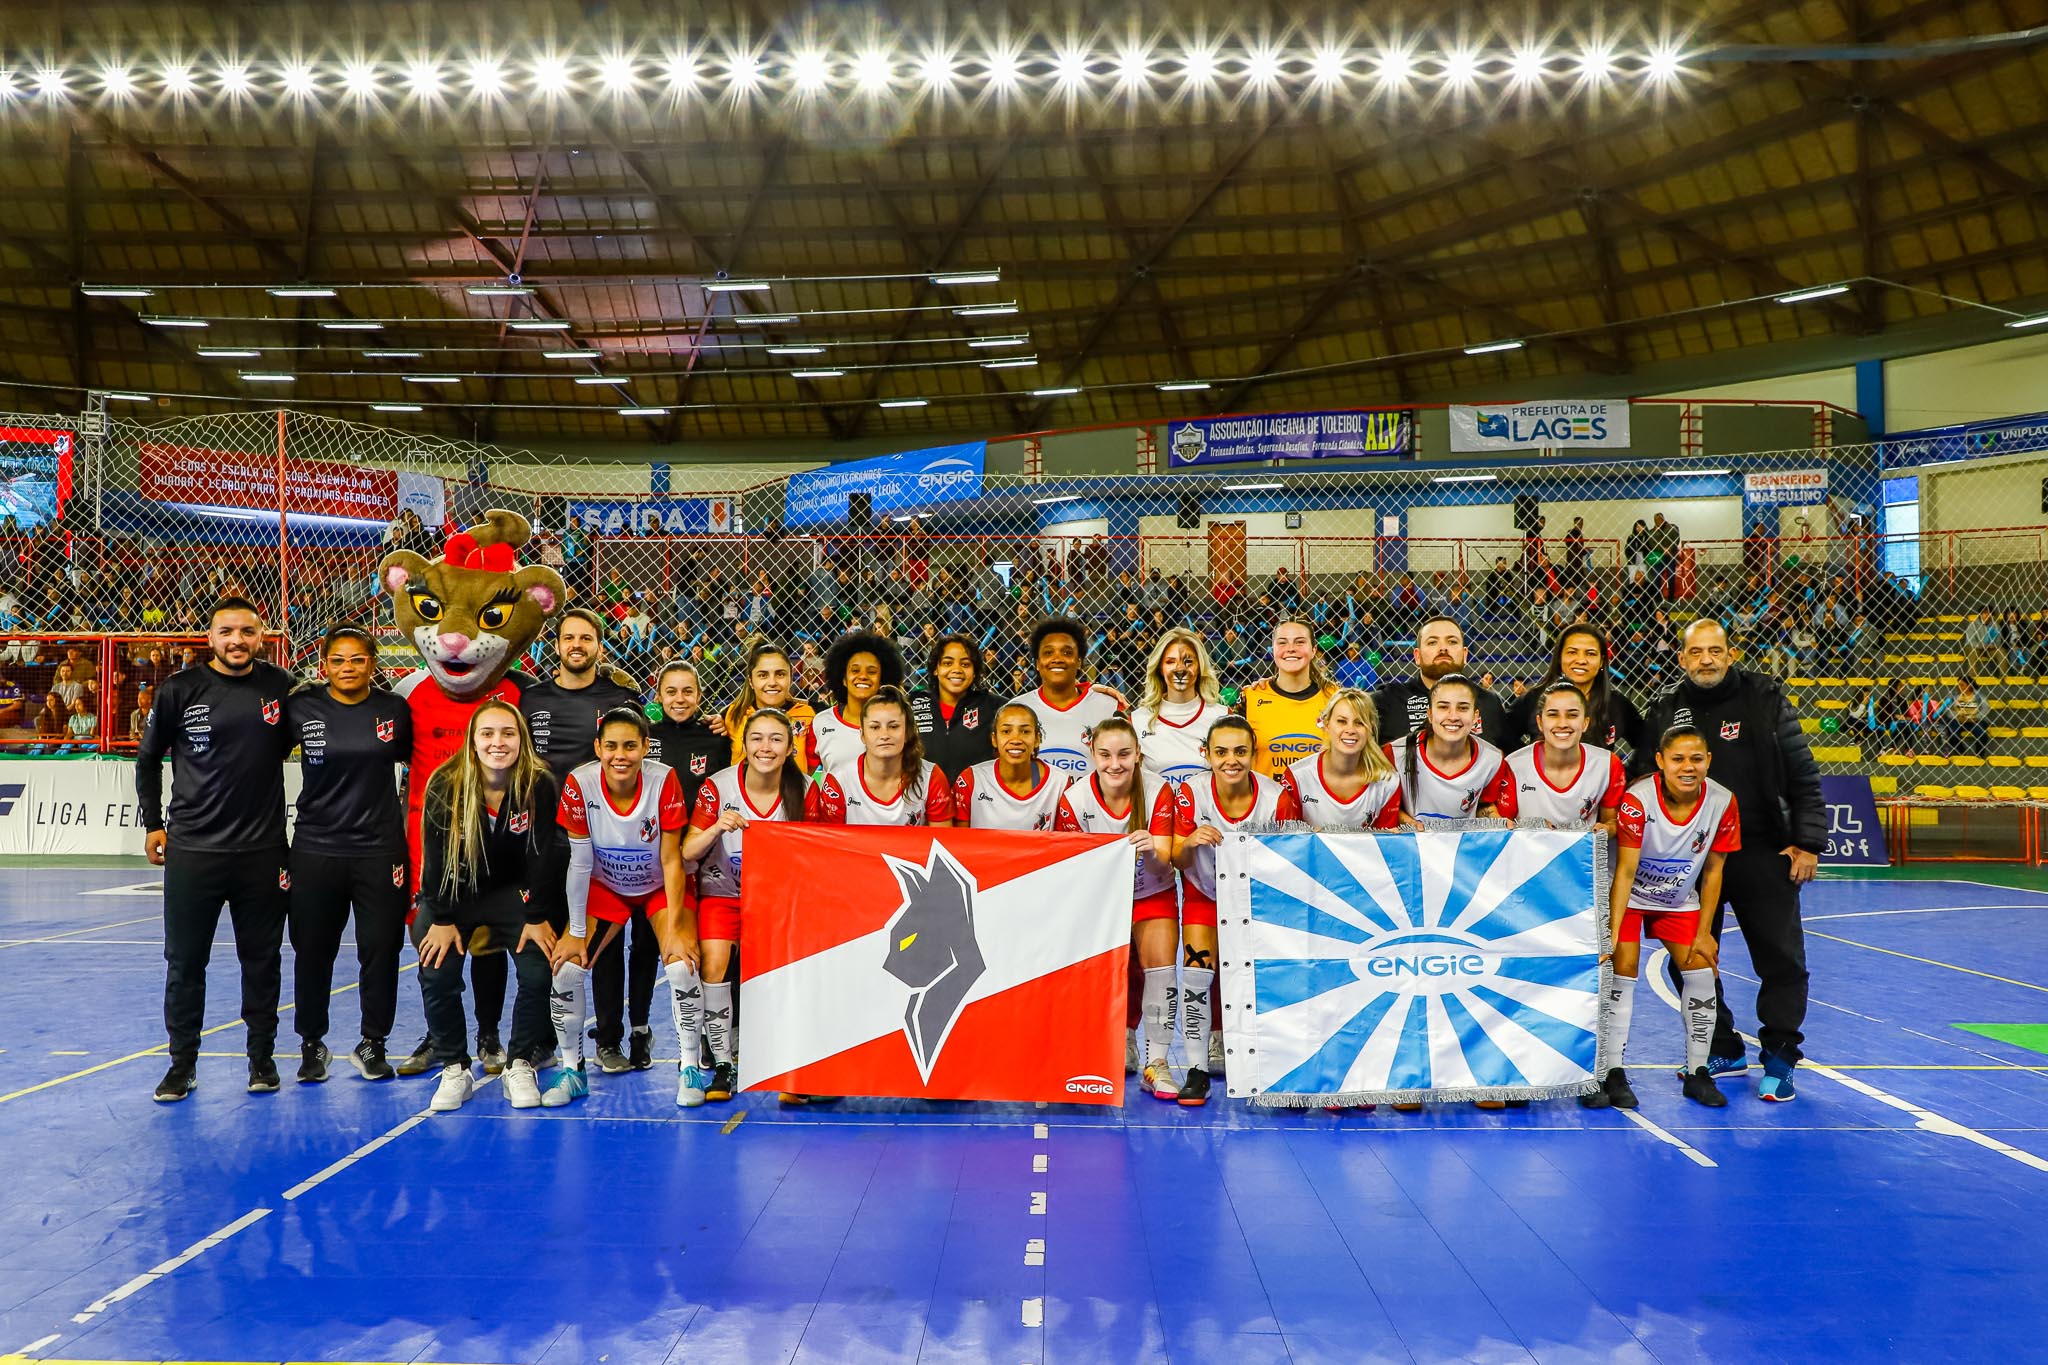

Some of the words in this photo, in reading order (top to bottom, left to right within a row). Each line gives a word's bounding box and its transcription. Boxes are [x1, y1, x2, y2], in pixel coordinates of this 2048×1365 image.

[1512, 405, 1587, 416] PREFEITURA
[1590, 404, 1607, 415] DE
[1209, 418, 1263, 442] ASSOCIAÇÃO
[1264, 417, 1305, 436] LAGEANA
[1307, 417, 1319, 434] DE
[1321, 415, 1363, 434] VOLEIBOL
[1365, 413, 1399, 451] ALV
[1513, 418, 1608, 442] LAGES
[1750, 474, 1822, 486] BANHEIRO
[1750, 490, 1822, 502] MASCULINO
[37, 801, 88, 826] LIGA
[1621, 803, 1642, 818] LFF
[599, 859, 653, 872] UNIPLAC
